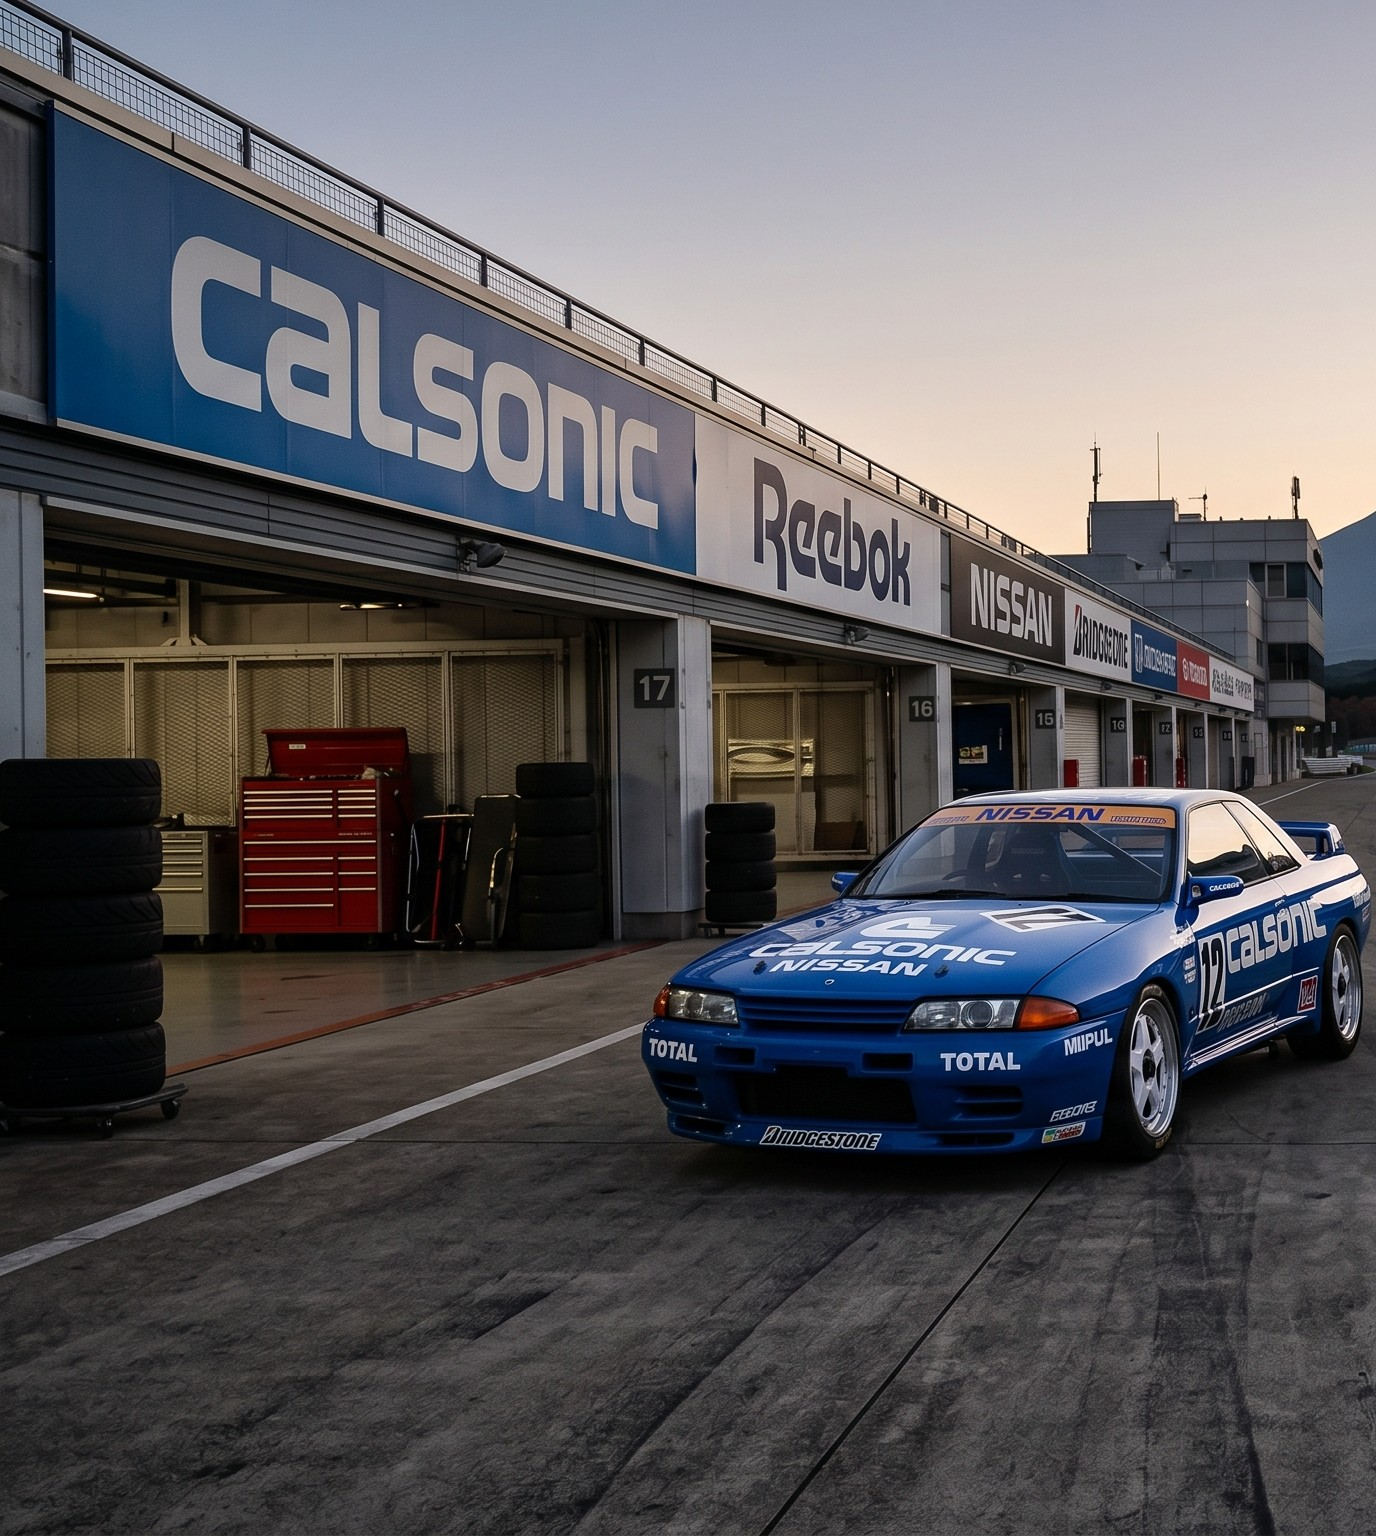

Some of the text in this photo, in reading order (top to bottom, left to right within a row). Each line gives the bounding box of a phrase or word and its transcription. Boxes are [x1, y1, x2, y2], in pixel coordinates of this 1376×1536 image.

[171, 236, 658, 530] CALSONIC
[754, 457, 910, 606] Reebok
[970, 563, 1052, 647] NISSAN
[639, 675, 671, 701] 17
[912, 700, 933, 717] 16
[974, 807, 1105, 821] NISSAN
[1226, 898, 1327, 974] CALSONIC
[749, 940, 1017, 966] CALSONIC
[769, 958, 928, 977] NISSAN
[1200, 937, 1225, 1015] 12
[649, 1038, 698, 1062] TOTAL
[940, 1052, 1021, 1072] TOTAL
[760, 1126, 882, 1151] BRIDGESTONE
